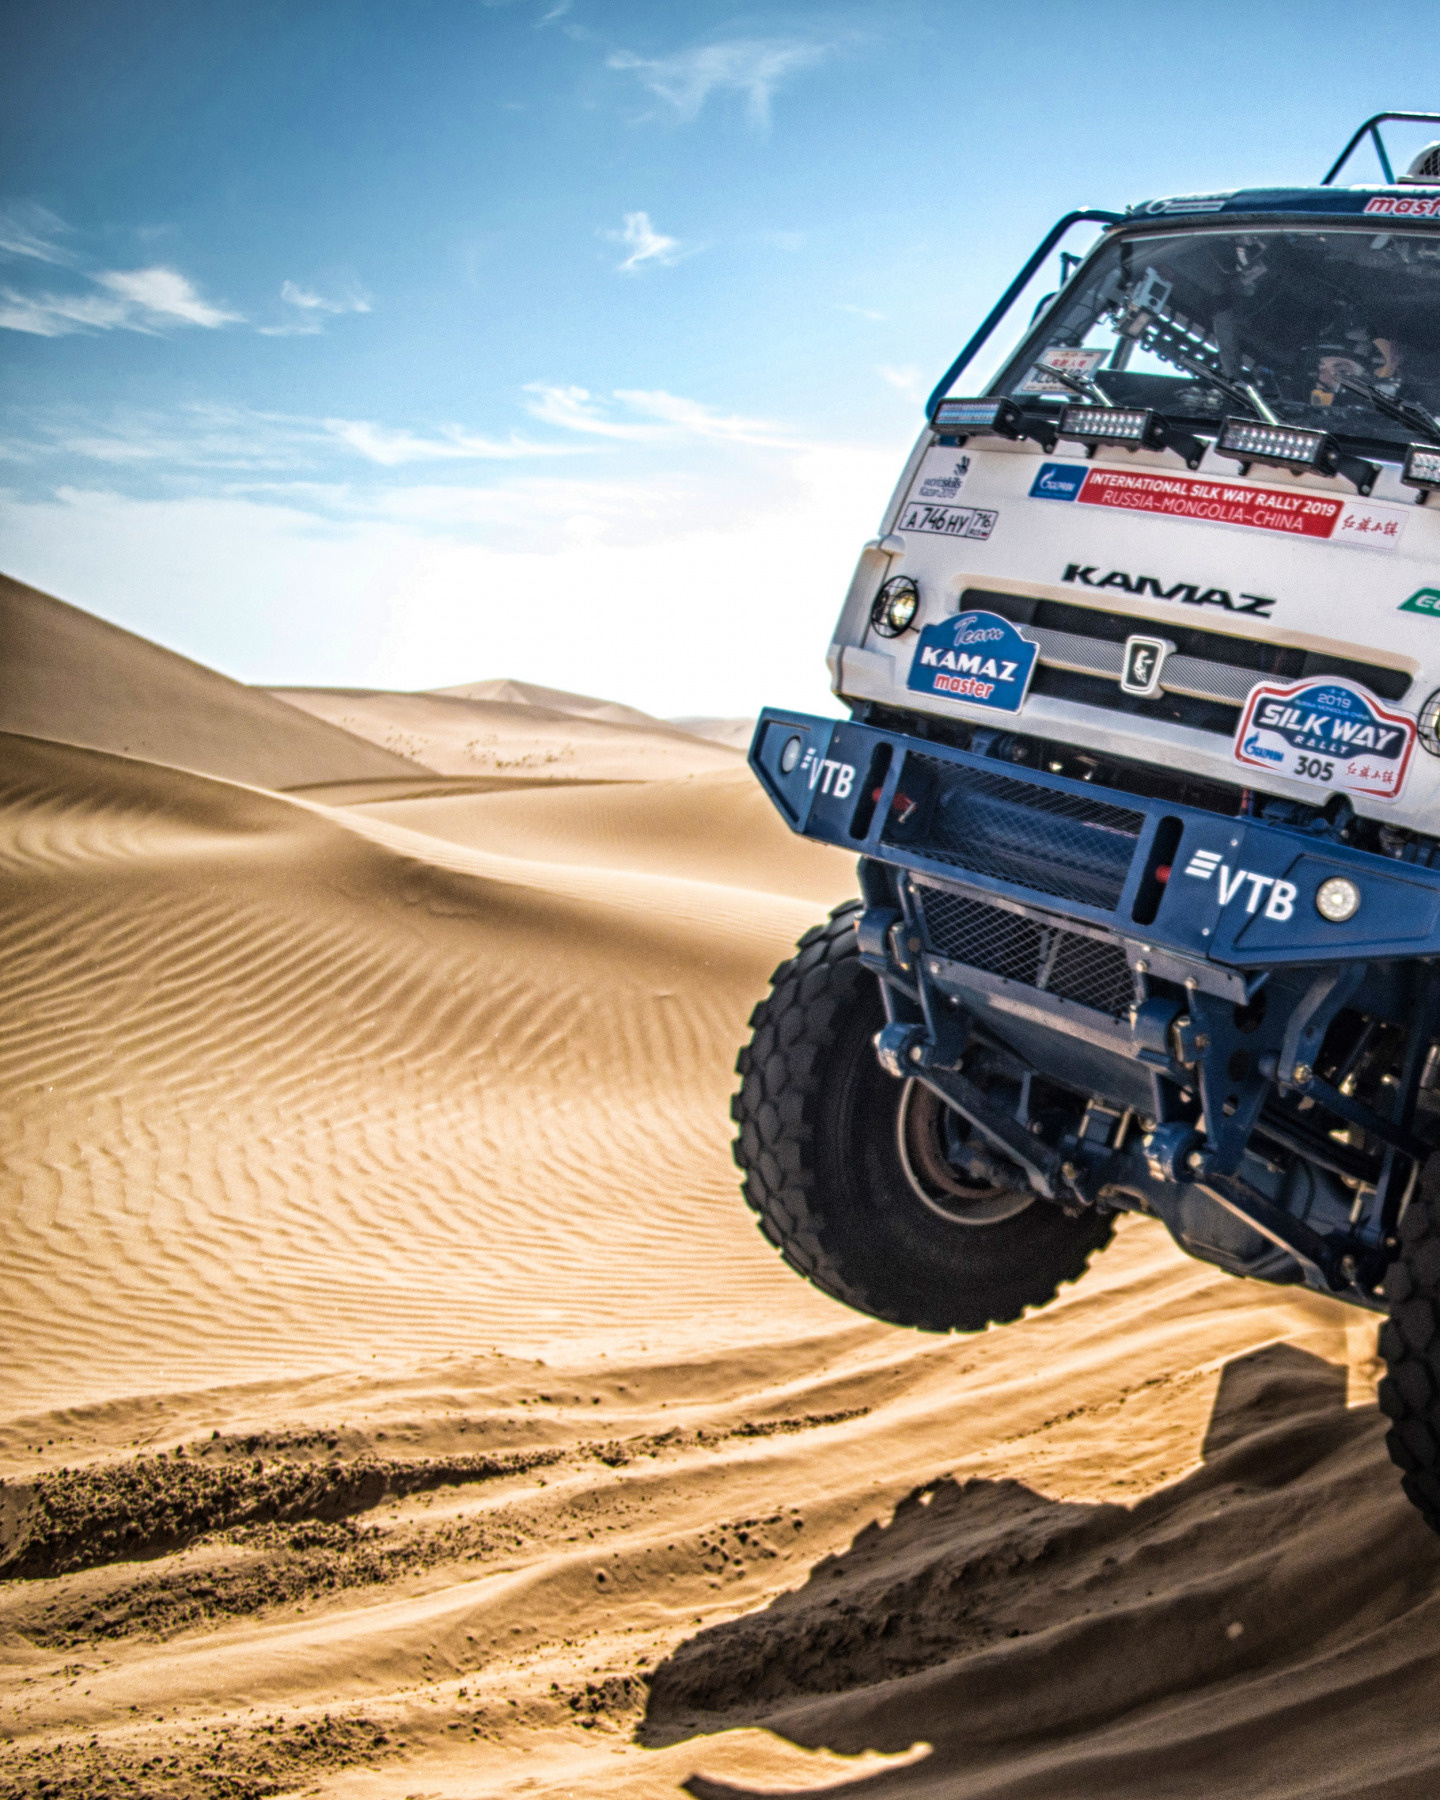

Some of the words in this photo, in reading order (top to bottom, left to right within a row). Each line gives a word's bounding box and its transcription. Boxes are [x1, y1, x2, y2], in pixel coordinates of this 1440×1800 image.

[1089, 472, 1188, 495] INTERNATIONAL
[1190, 485, 1222, 499] SILK
[1223, 489, 1255, 505] WAY
[1255, 493, 1303, 511] RALLY
[1302, 500, 1336, 516] 2019
[1061, 562, 1277, 619] KAMAZ
[954, 616, 1004, 647] Team
[920, 646, 1018, 682] KAMAZ
[933, 673, 995, 699] master
[1317, 693, 1351, 709] 2019
[1259, 703, 1331, 738] SILK
[1331, 717, 1399, 750] WAY
[1293, 735, 1350, 754] RALLY
[808, 757, 856, 799] VTB
[1294, 754, 1335, 782] 305
[1218, 864, 1297, 921] VTB
